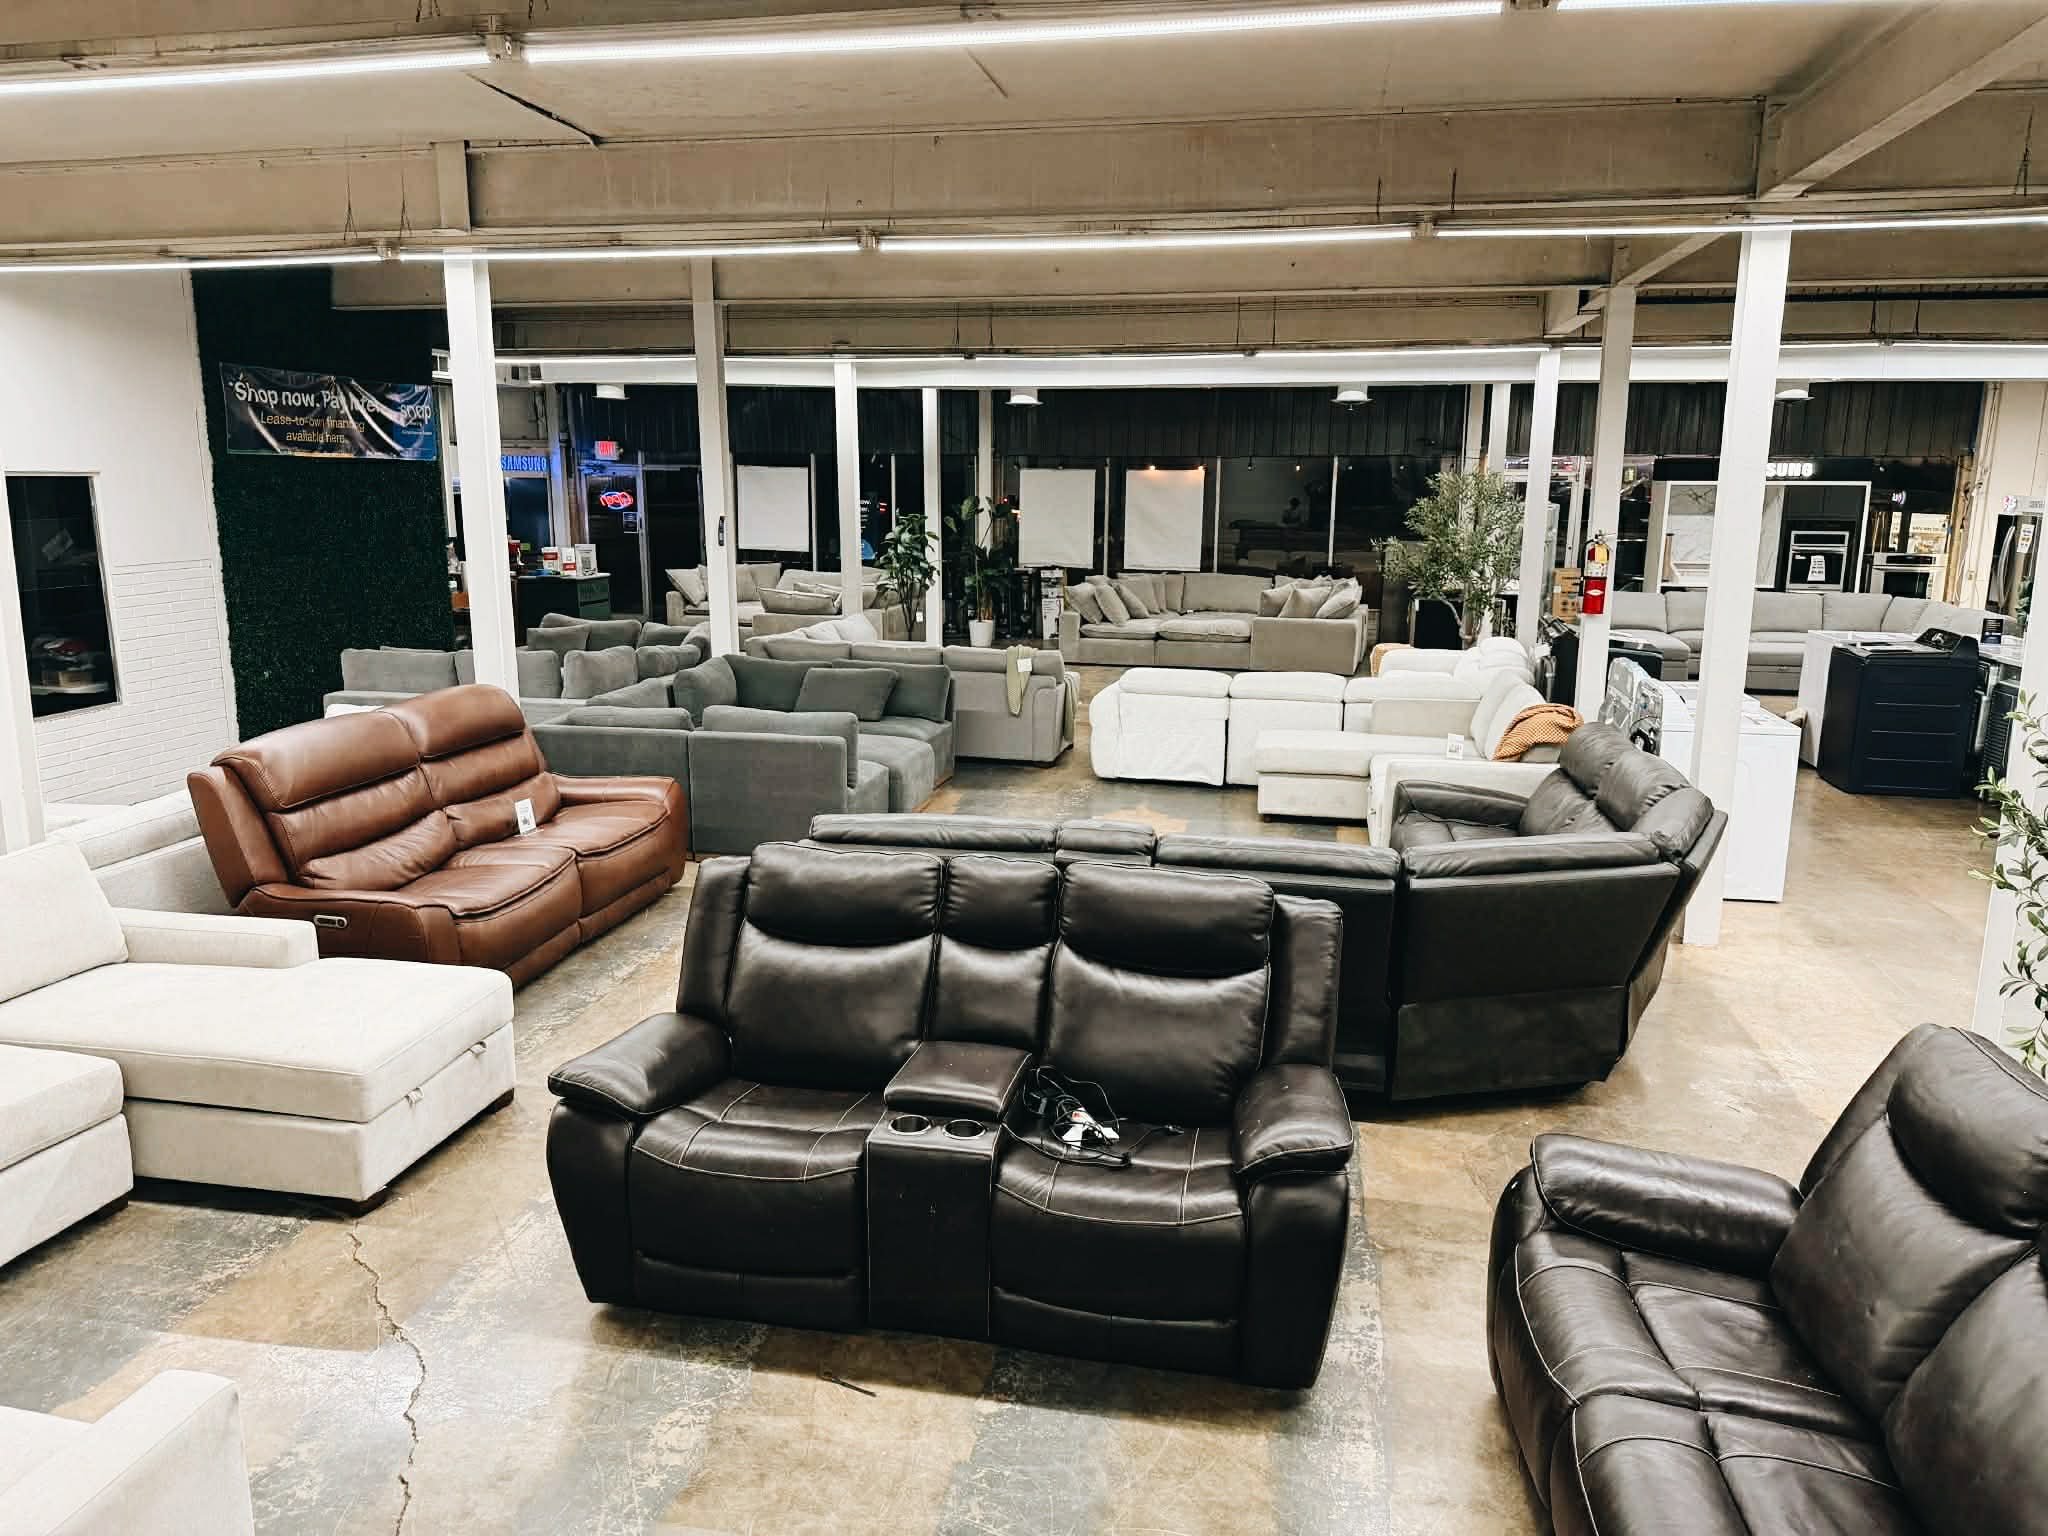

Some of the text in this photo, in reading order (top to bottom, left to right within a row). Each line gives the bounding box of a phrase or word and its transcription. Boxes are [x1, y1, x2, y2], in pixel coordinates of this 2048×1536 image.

[234, 381, 278, 408] Shop
[282, 391, 320, 408] now.
[321, 389, 346, 414] Pay
[327, 415, 365, 432] finanng
[501, 456, 547, 471] SAMSUNG
[1765, 462, 1813, 477] SUNG
